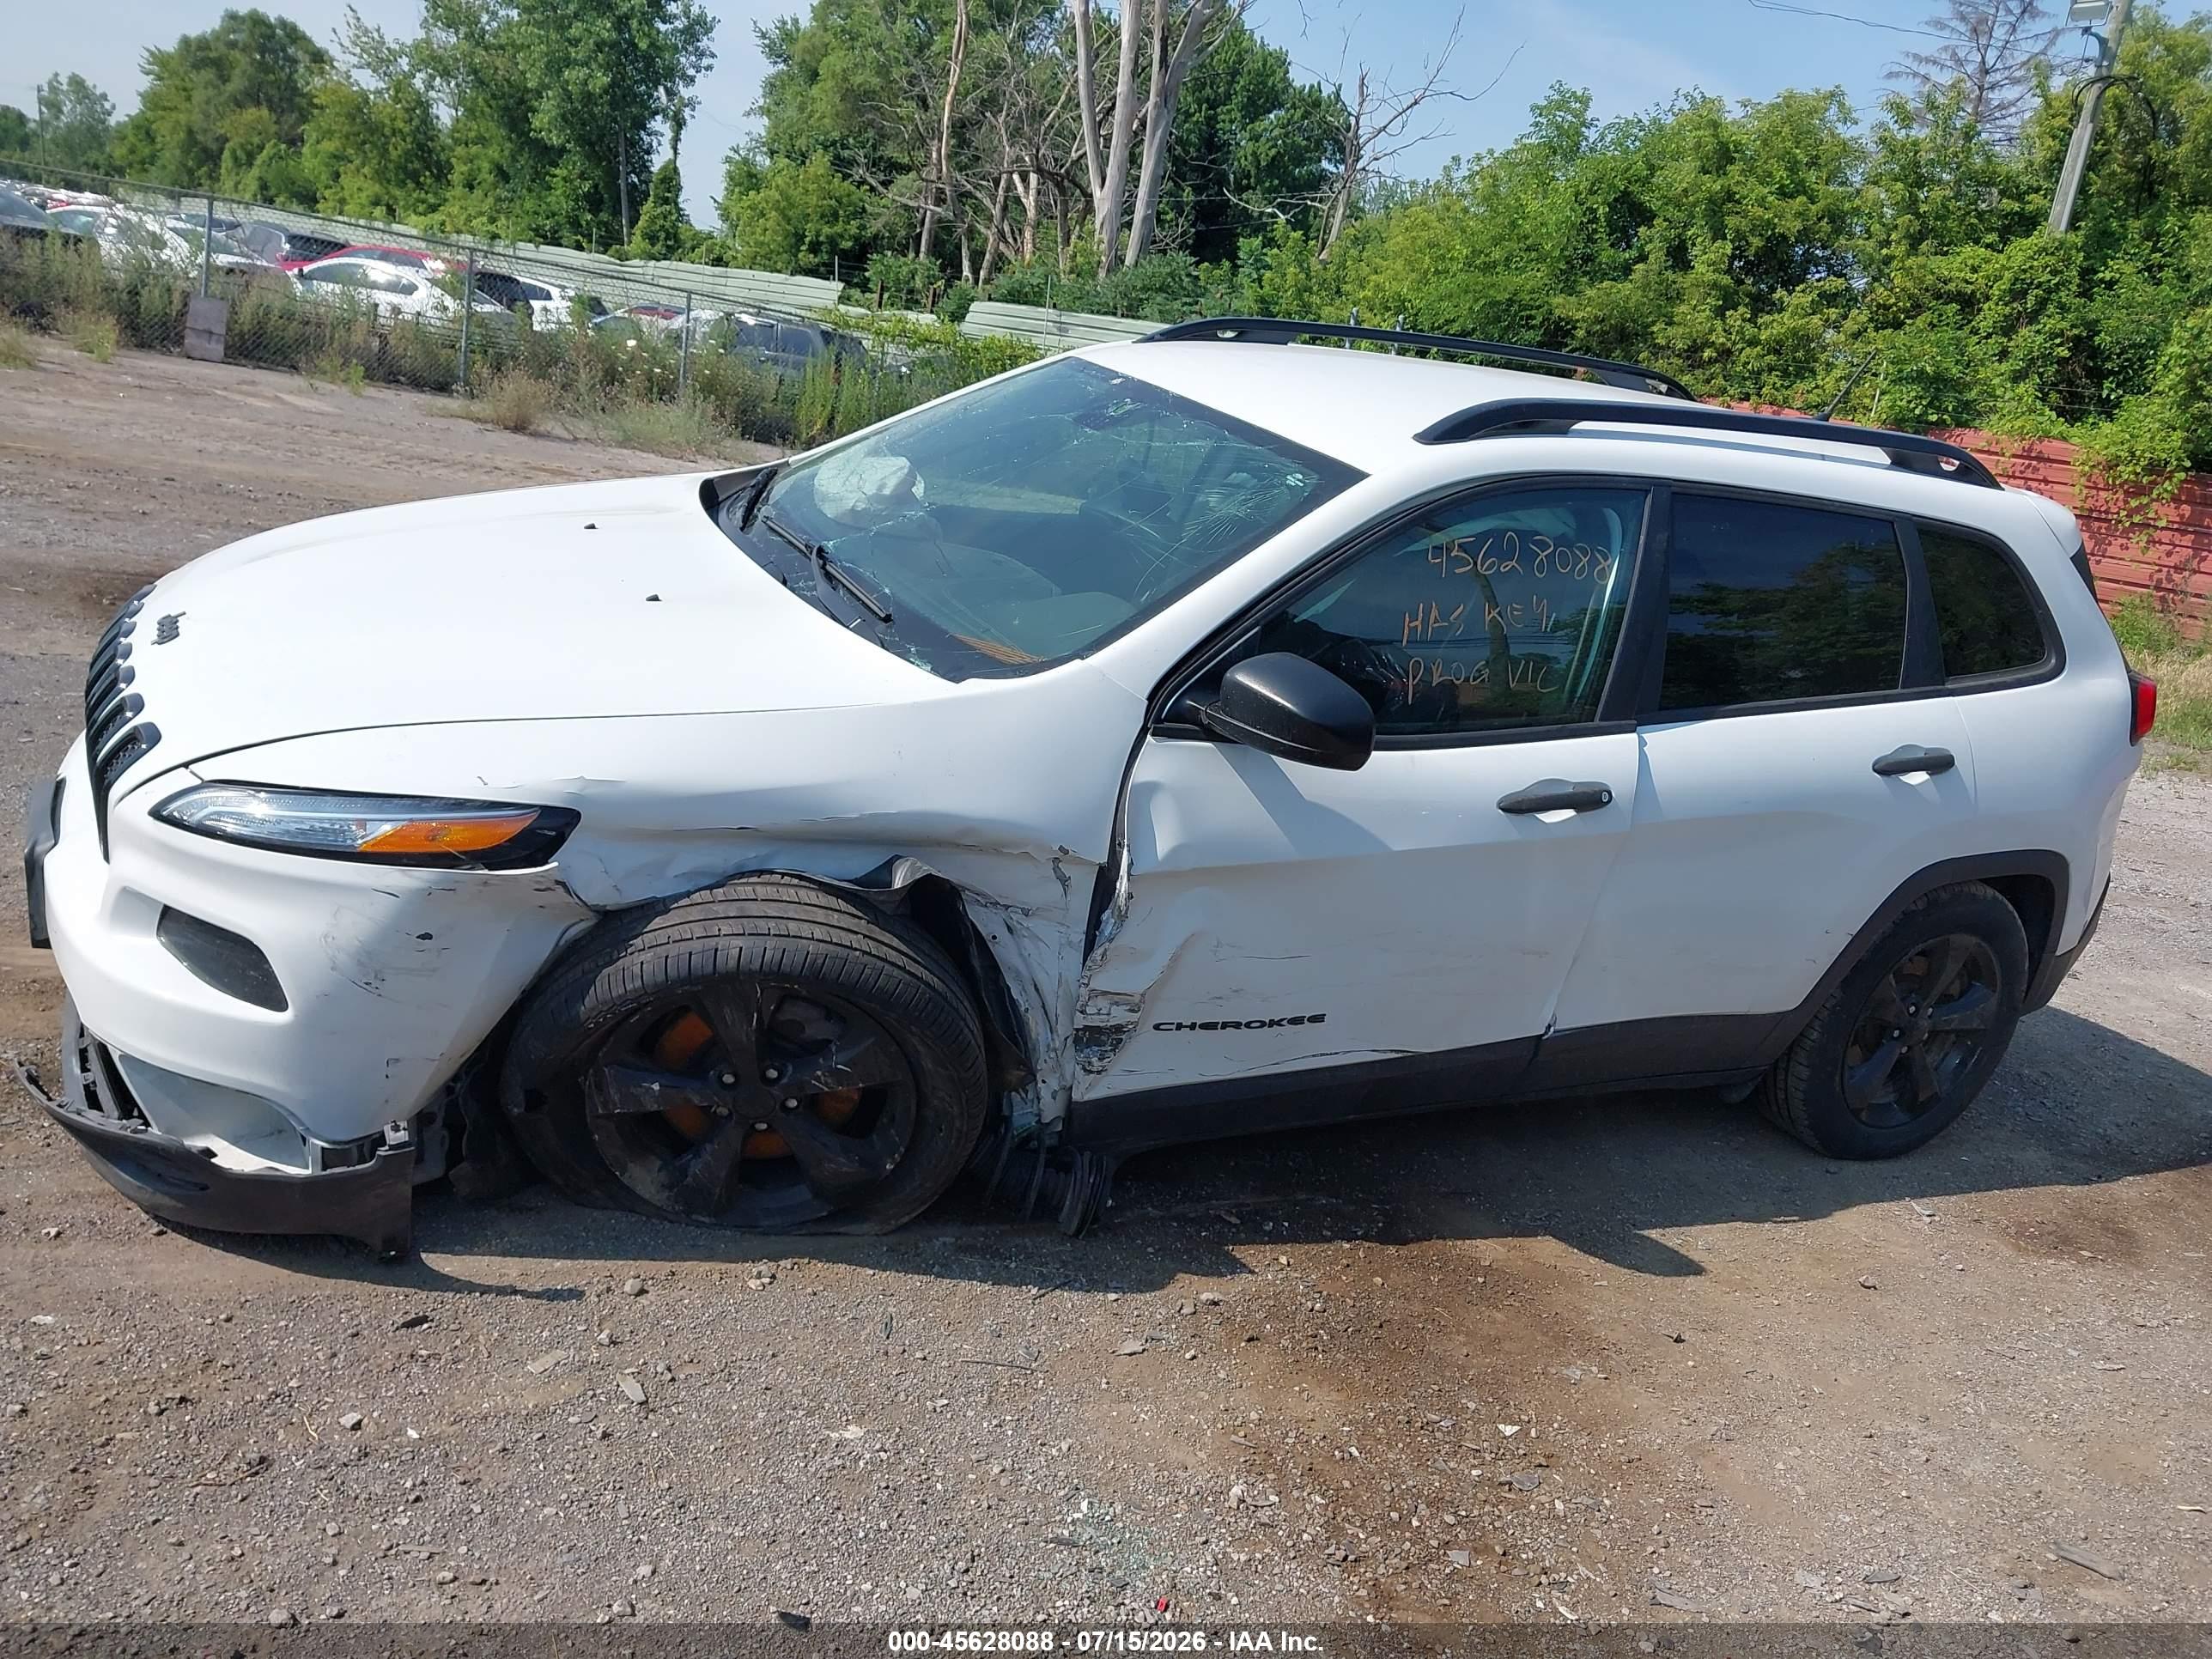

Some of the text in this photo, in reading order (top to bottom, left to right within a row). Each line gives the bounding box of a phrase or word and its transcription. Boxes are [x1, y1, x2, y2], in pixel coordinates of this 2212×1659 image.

[1427, 531, 1613, 585] 45628088
[1401, 601, 1465, 647] HAS
[1407, 657, 1559, 706] PROG VIC
[1152, 1013, 1327, 1031] CHEROKEE
